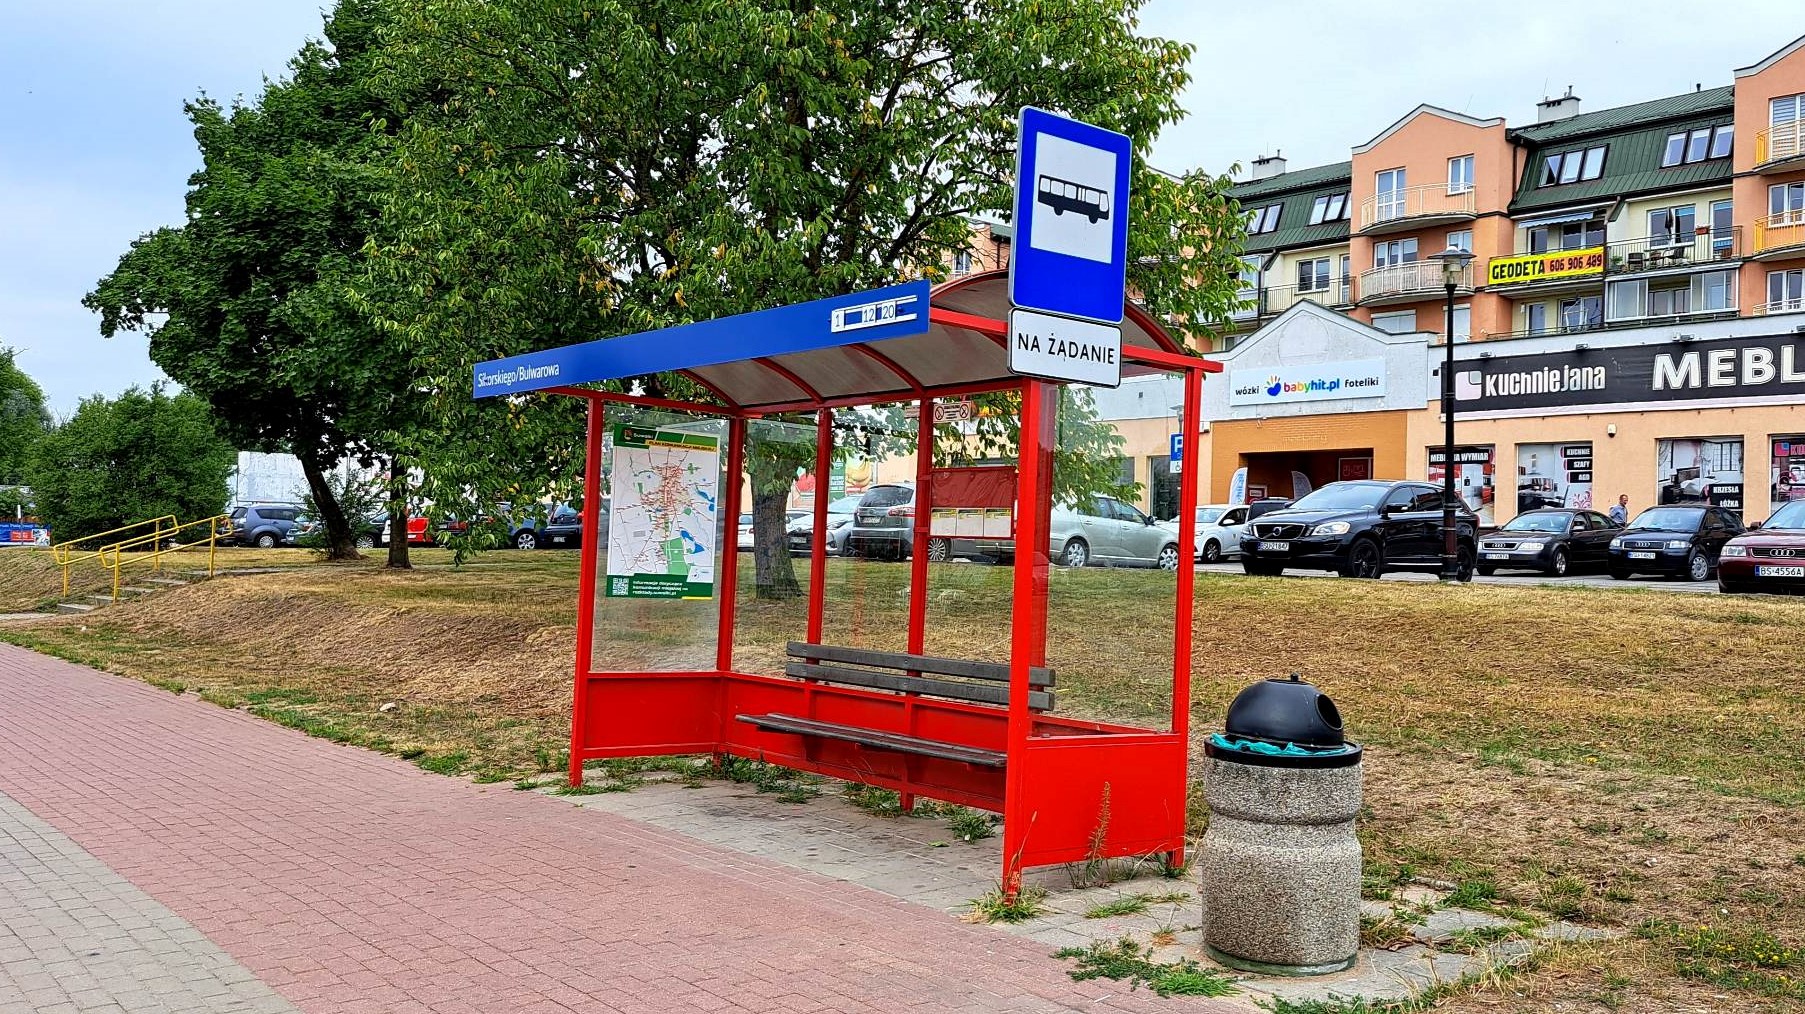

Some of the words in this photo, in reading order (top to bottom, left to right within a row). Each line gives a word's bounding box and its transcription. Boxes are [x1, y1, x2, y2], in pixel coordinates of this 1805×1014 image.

[1492, 260, 1546, 279] GEODETA
[1550, 259, 1564, 272] 606
[1568, 256, 1583, 270] 906
[1586, 254, 1602, 267] 489
[835, 314, 840, 327] 1
[863, 308, 875, 322] 12
[882, 304, 895, 319] 20
[1018, 332, 1041, 353] NA
[1048, 332, 1115, 365] ŻĄDANIE
[1235, 385, 1260, 396] wózki
[1283, 378, 1340, 393] babyhit.pl
[1344, 376, 1379, 388] foteliki
[1461, 452, 1489, 461] WYMIAR
[1573, 460, 1590, 468] SZAFY
[1760, 567, 1772, 576] BS
[1774, 567, 1802, 576] 4556A
